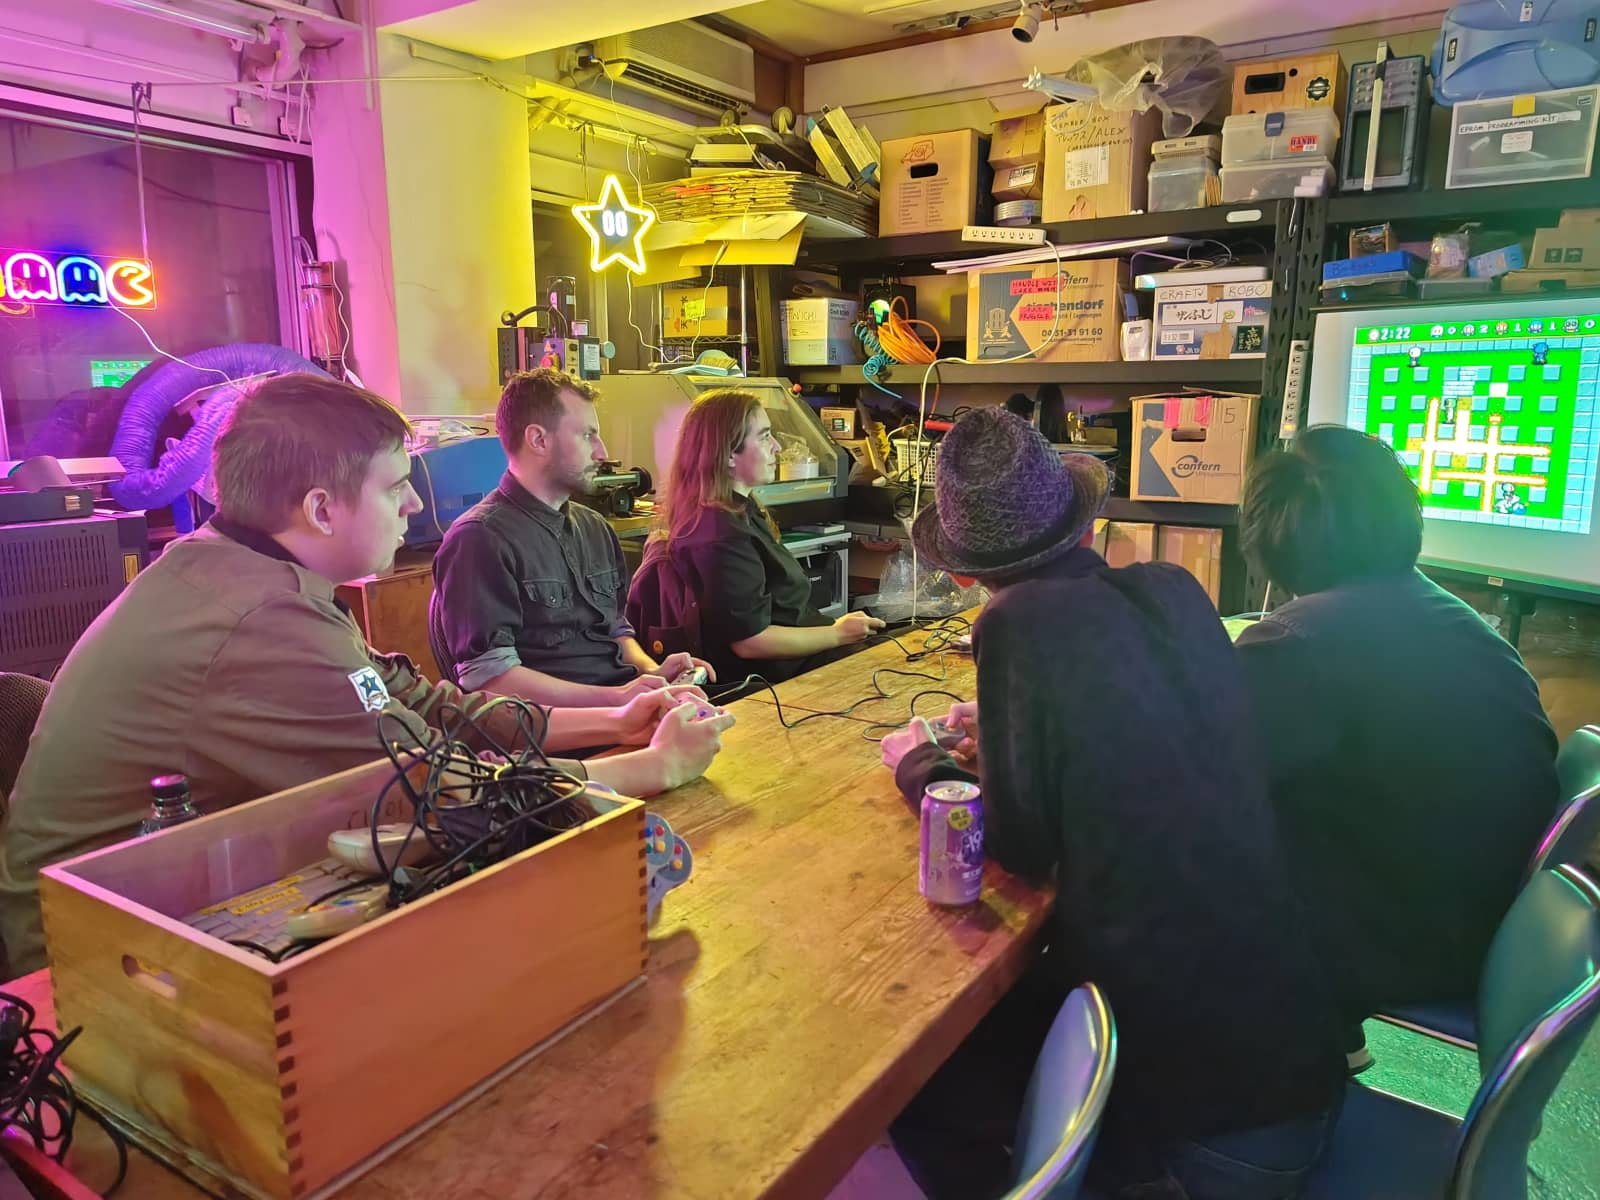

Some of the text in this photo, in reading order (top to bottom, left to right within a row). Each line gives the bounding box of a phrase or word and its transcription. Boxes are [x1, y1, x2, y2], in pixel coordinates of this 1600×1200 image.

[1542, 115, 1556, 123] KIT
[1381, 327, 1411, 340] 2:22
[1480, 325, 1488, 333] 2
[1514, 323, 1521, 332] 1
[1549, 321, 1556, 331] 1
[1585, 319, 1595, 329] 0
[1224, 407, 1236, 424] 5
[1177, 462, 1221, 472] confern
